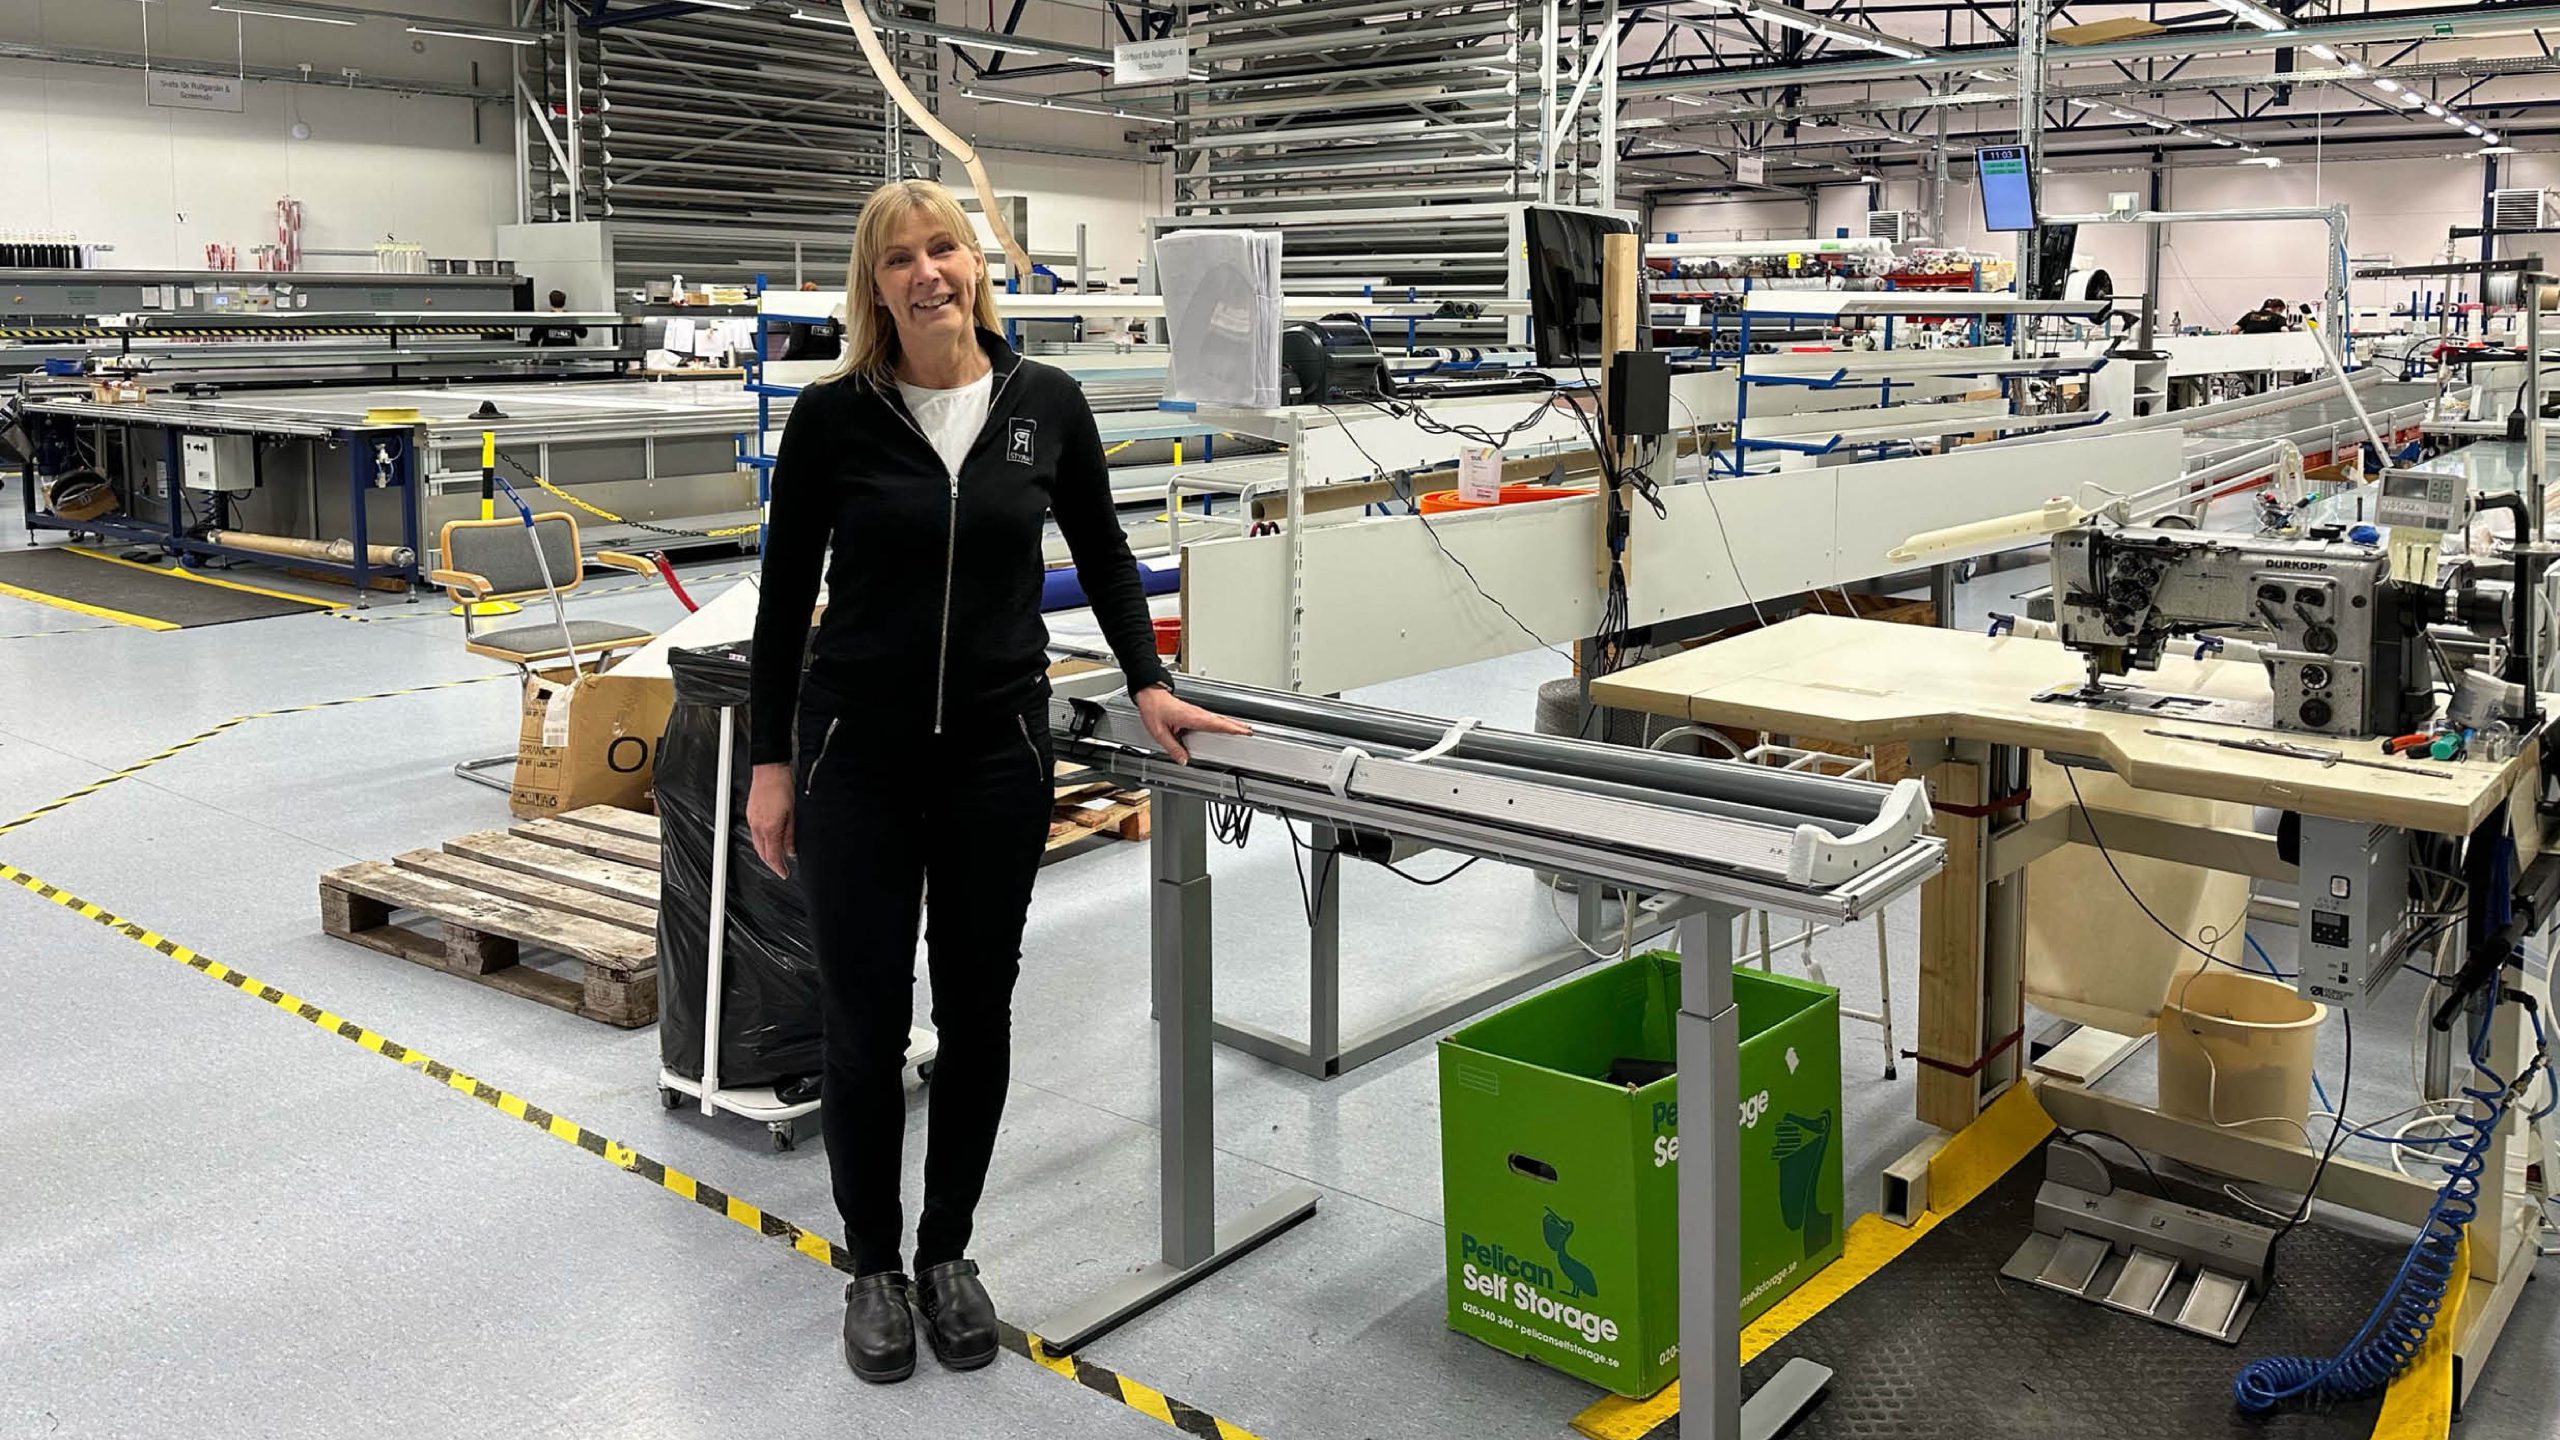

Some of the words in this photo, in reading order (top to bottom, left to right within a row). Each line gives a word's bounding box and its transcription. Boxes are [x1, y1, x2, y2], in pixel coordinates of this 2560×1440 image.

[1990, 150, 2014, 160] 11:03
[1461, 1231, 1553, 1290] Pelican
[1463, 1263, 1508, 1303] Self
[1513, 1281, 1619, 1344] Storage
[1462, 1302, 1496, 1322] 020-340
[1497, 1315, 1514, 1328] 340
[1520, 1325, 1620, 1368] pelicanselfstorage.se
